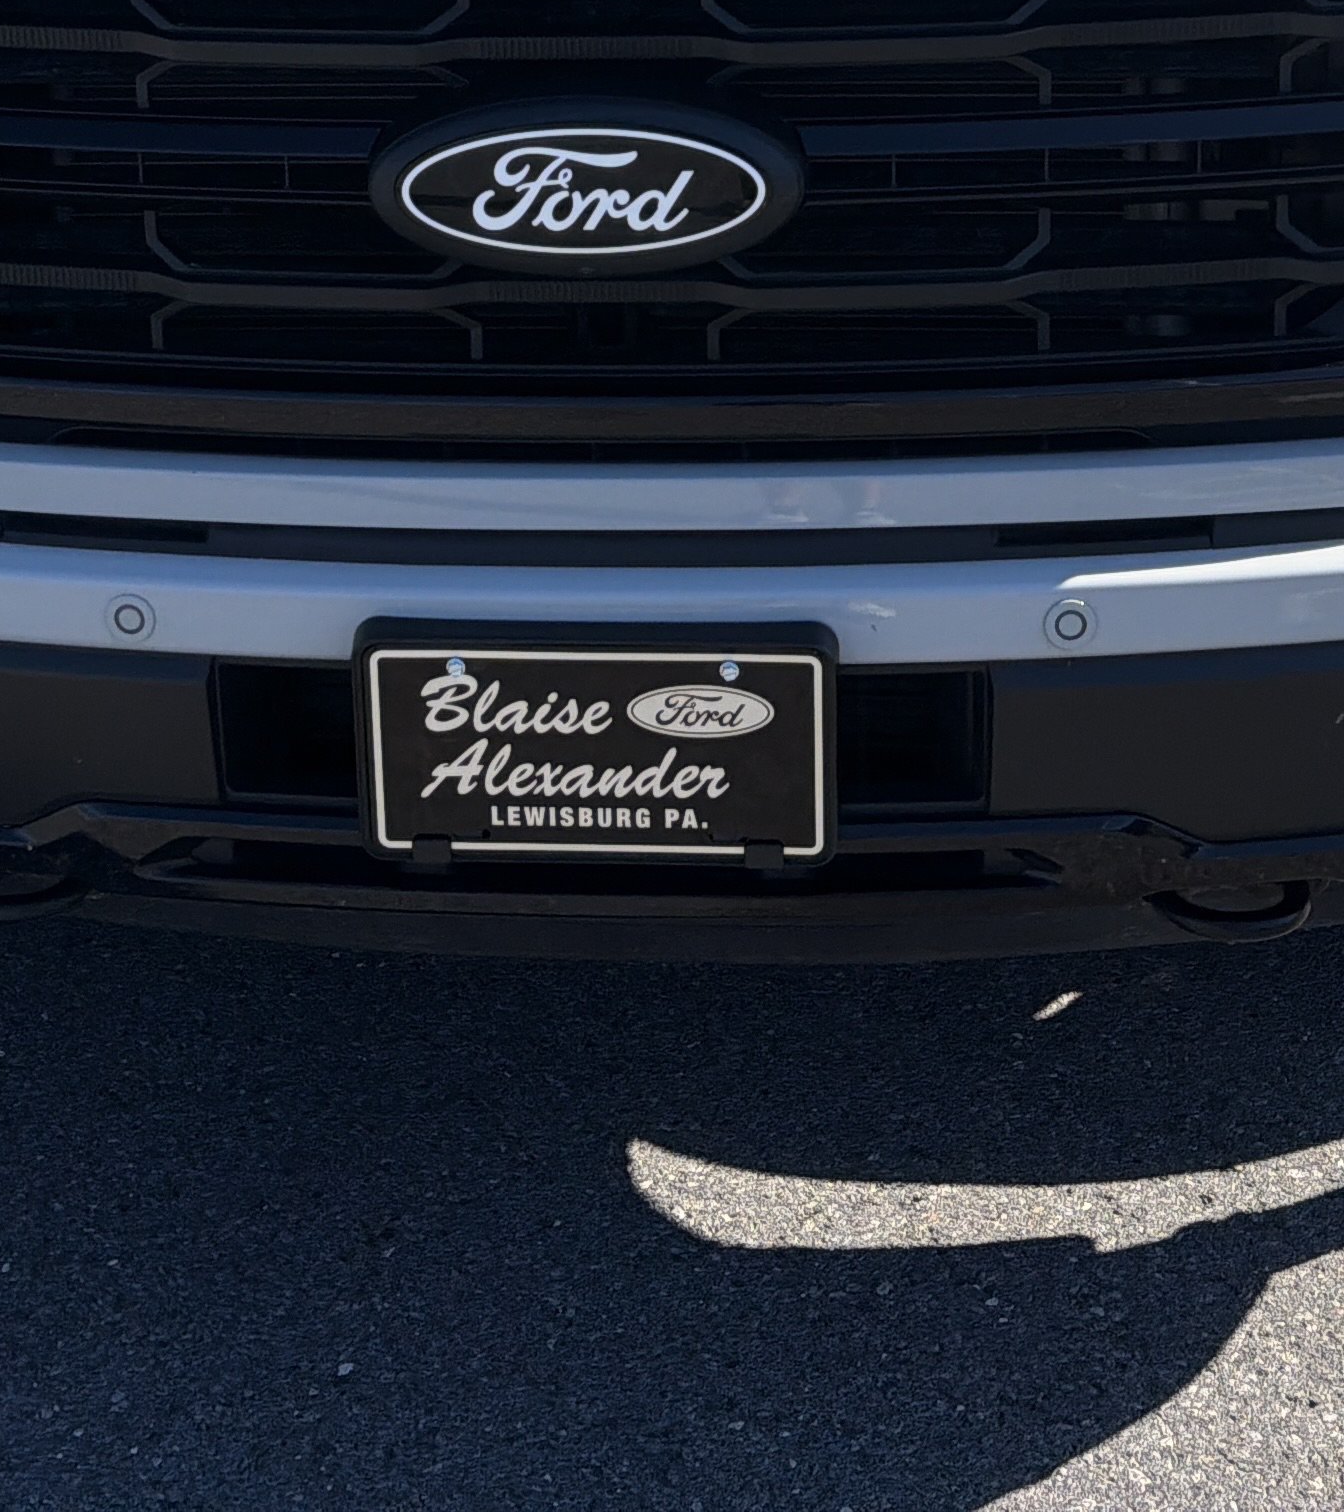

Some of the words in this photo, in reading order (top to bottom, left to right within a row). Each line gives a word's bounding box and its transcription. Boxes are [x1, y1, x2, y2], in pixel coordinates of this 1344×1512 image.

[472, 146, 695, 232] Ford
[420, 674, 613, 736] Blaise
[654, 691, 746, 728] Ford
[420, 738, 731, 800] Alexander
[490, 805, 652, 829] LEWISBURG
[664, 807, 709, 830] PA.
